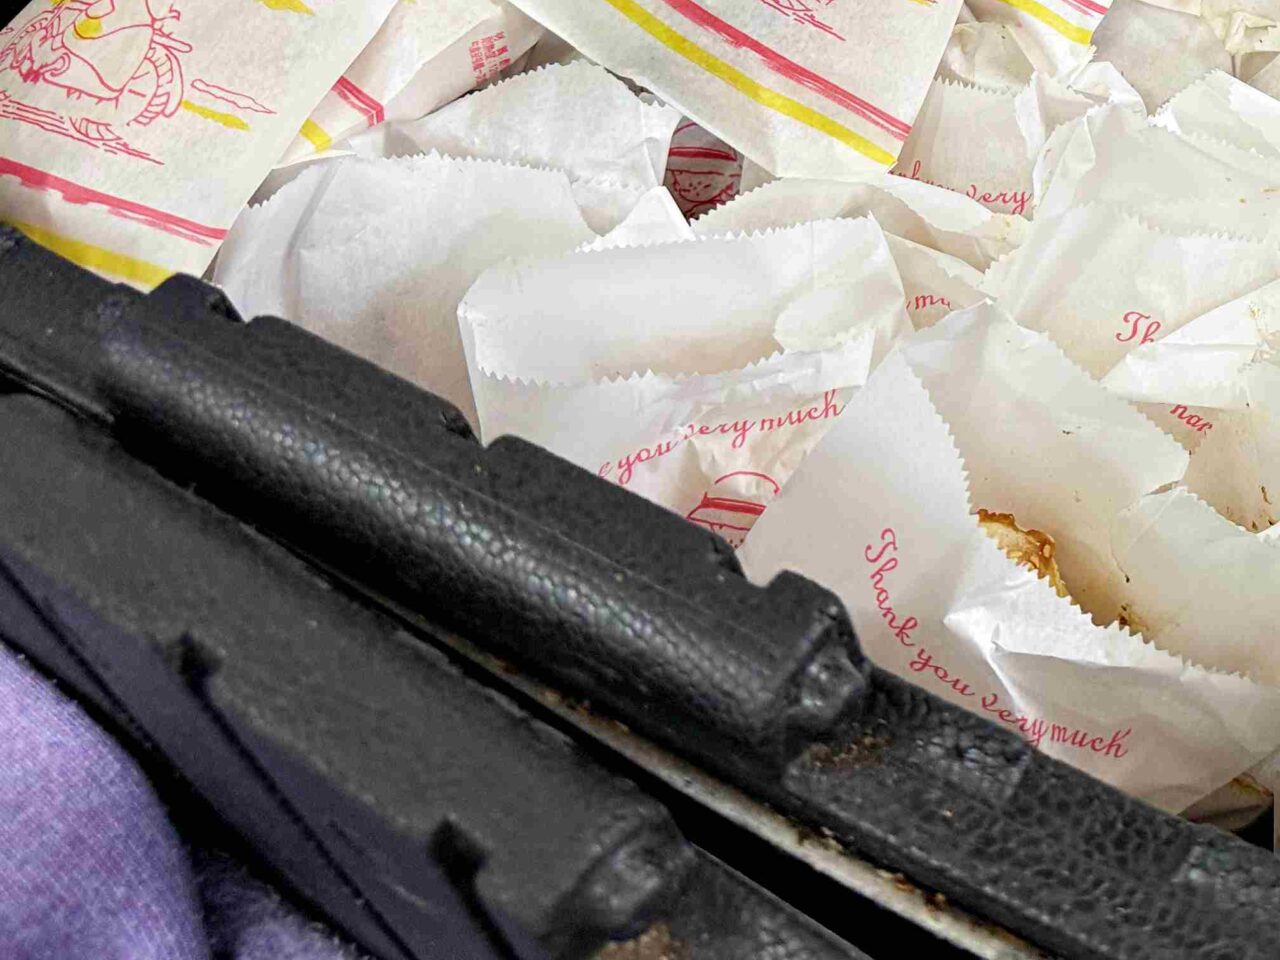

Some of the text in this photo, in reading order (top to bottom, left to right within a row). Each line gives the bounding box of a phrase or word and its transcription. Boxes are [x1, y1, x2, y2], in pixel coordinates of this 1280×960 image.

[616, 439, 679, 486] you
[759, 388, 847, 432] much
[864, 527, 919, 647] Thank
[909, 647, 975, 697] you
[1049, 723, 1132, 759] much
